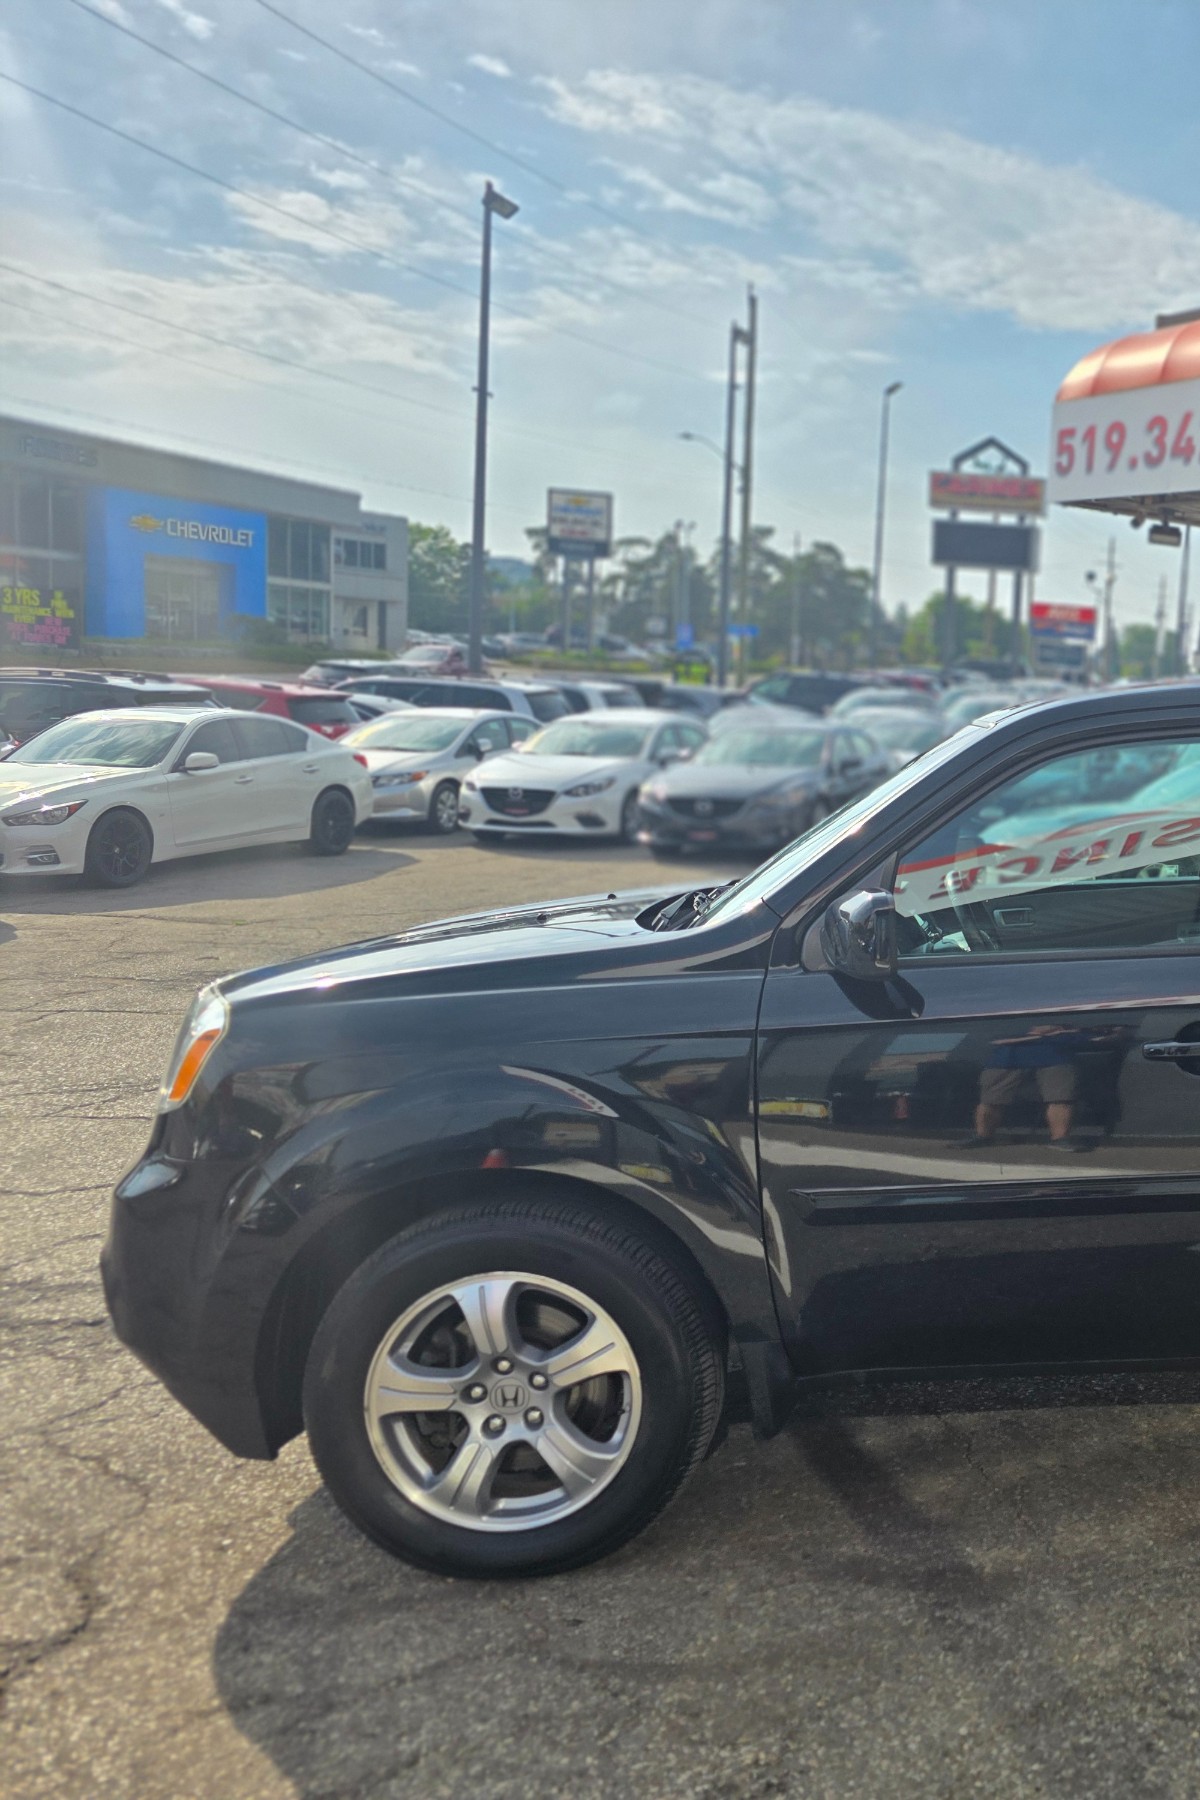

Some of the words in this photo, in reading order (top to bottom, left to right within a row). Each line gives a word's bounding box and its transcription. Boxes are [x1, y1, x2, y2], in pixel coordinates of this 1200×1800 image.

[166, 518, 254, 548] CHEVROLET
[2, 587, 13, 605] 3
[15, 588, 40, 607] YRS
